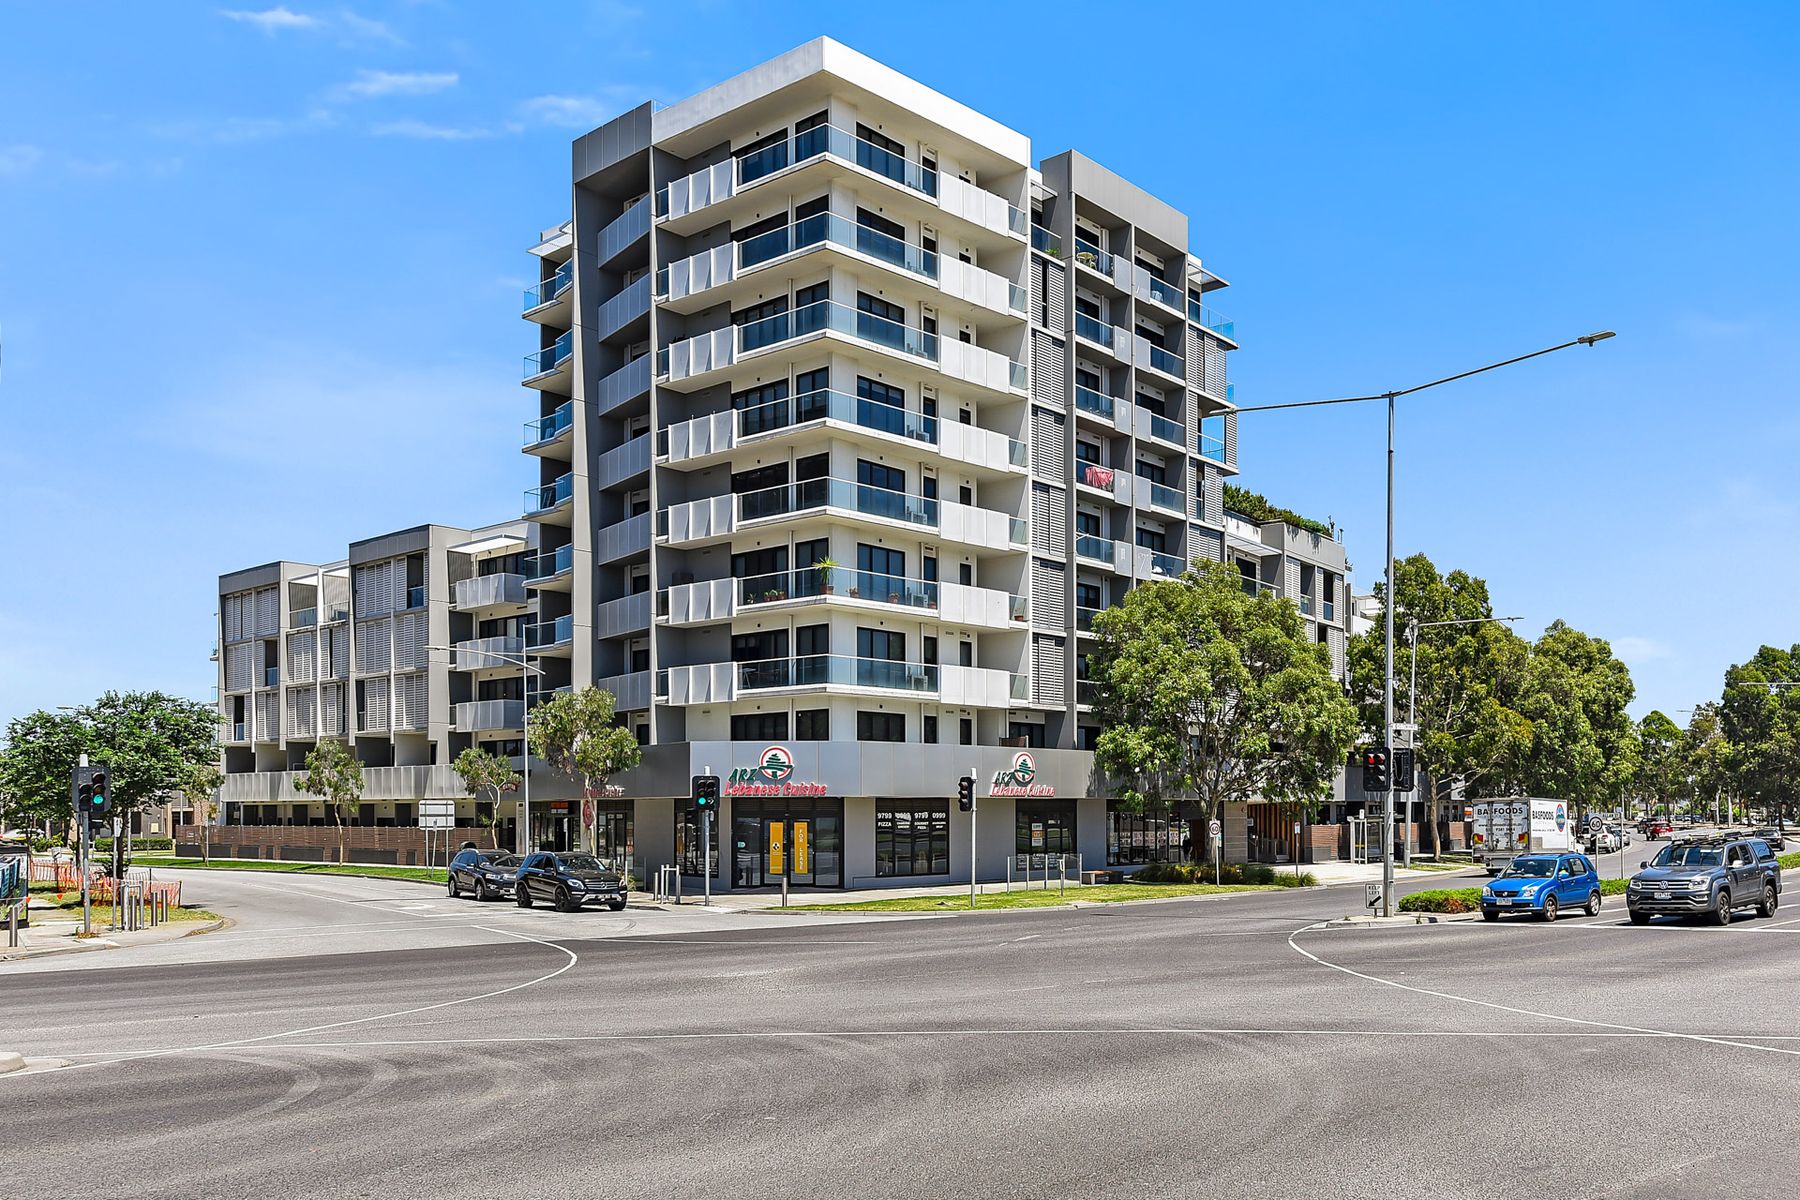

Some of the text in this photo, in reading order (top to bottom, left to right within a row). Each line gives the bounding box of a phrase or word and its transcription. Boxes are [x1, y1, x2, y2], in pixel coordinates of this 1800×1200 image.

[728, 768, 757, 781] ARZ
[724, 781, 827, 795] Lebanese Cuisine
[990, 784, 1057, 796] Lebanese Cuisine
[1592, 820, 1600, 828] 60
